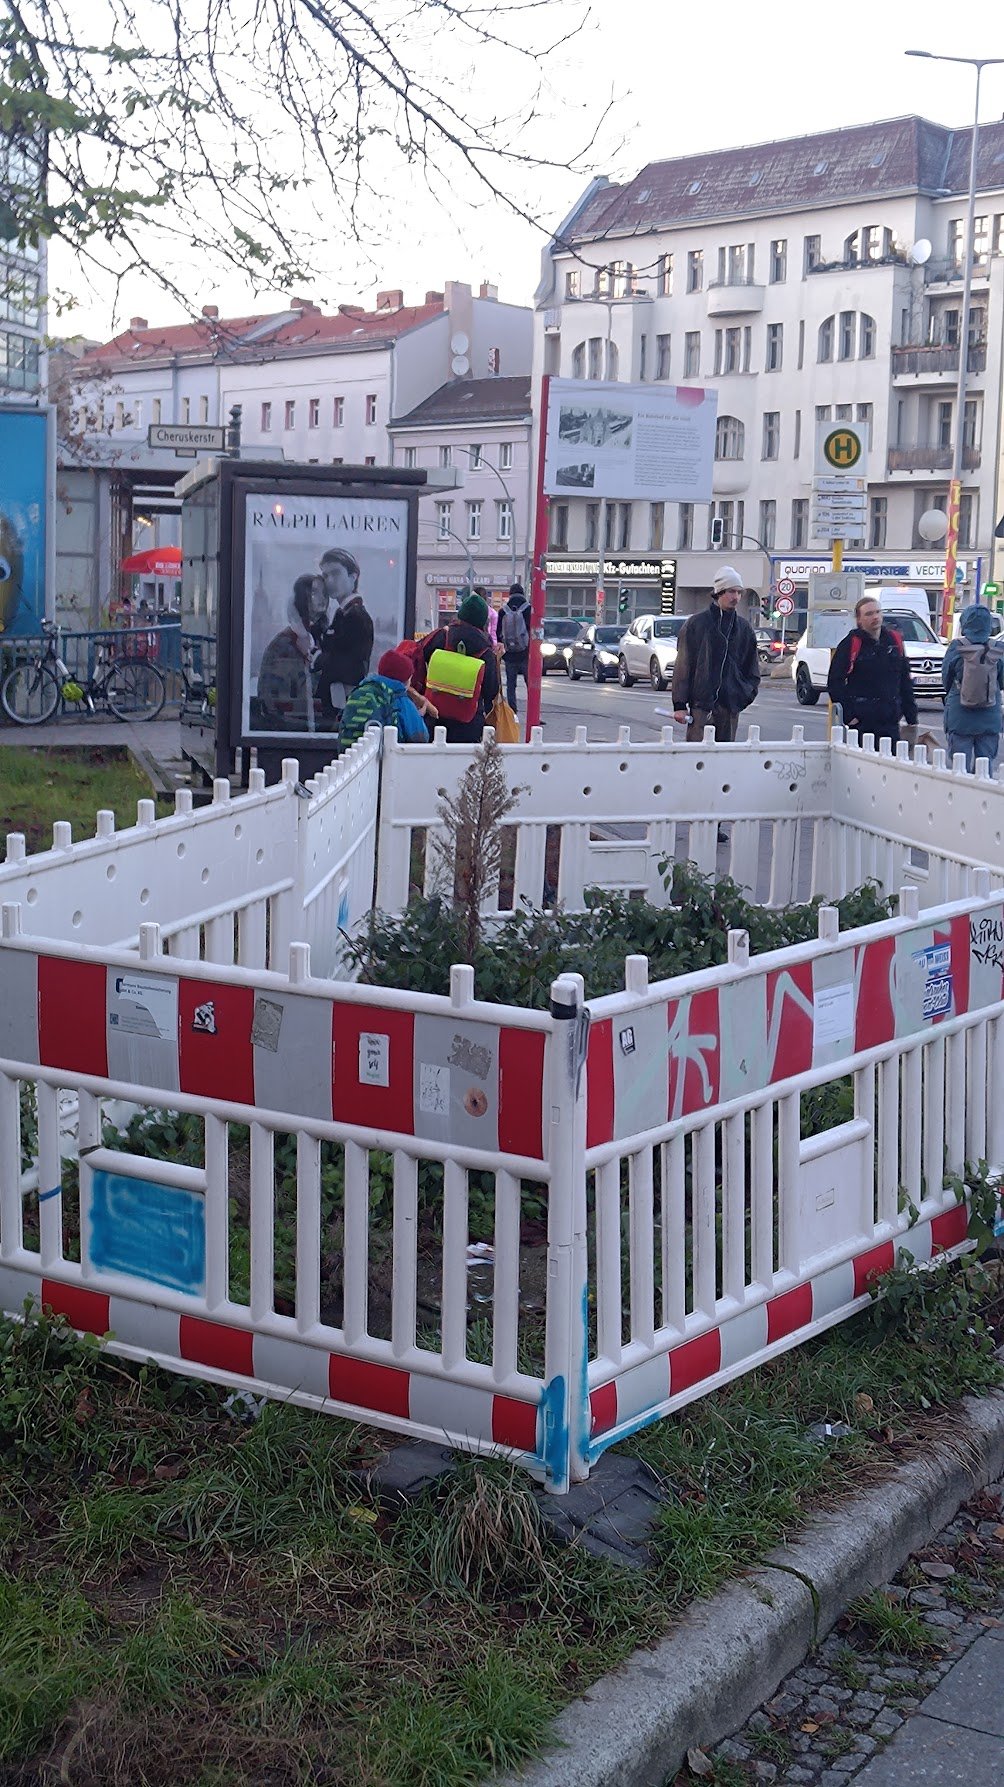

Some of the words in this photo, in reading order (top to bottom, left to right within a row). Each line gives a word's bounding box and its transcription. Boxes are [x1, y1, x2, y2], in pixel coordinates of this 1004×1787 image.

[157, 429, 216, 443] Cheruskerstr.
[834, 437, 852, 460] H
[253, 512, 316, 529] RALPH
[326, 514, 400, 532] LAUREN
[603, 562, 660, 575] Kfz-Gutachten
[915, 566, 946, 576] VECTR
[782, 582, 791, 591] 20
